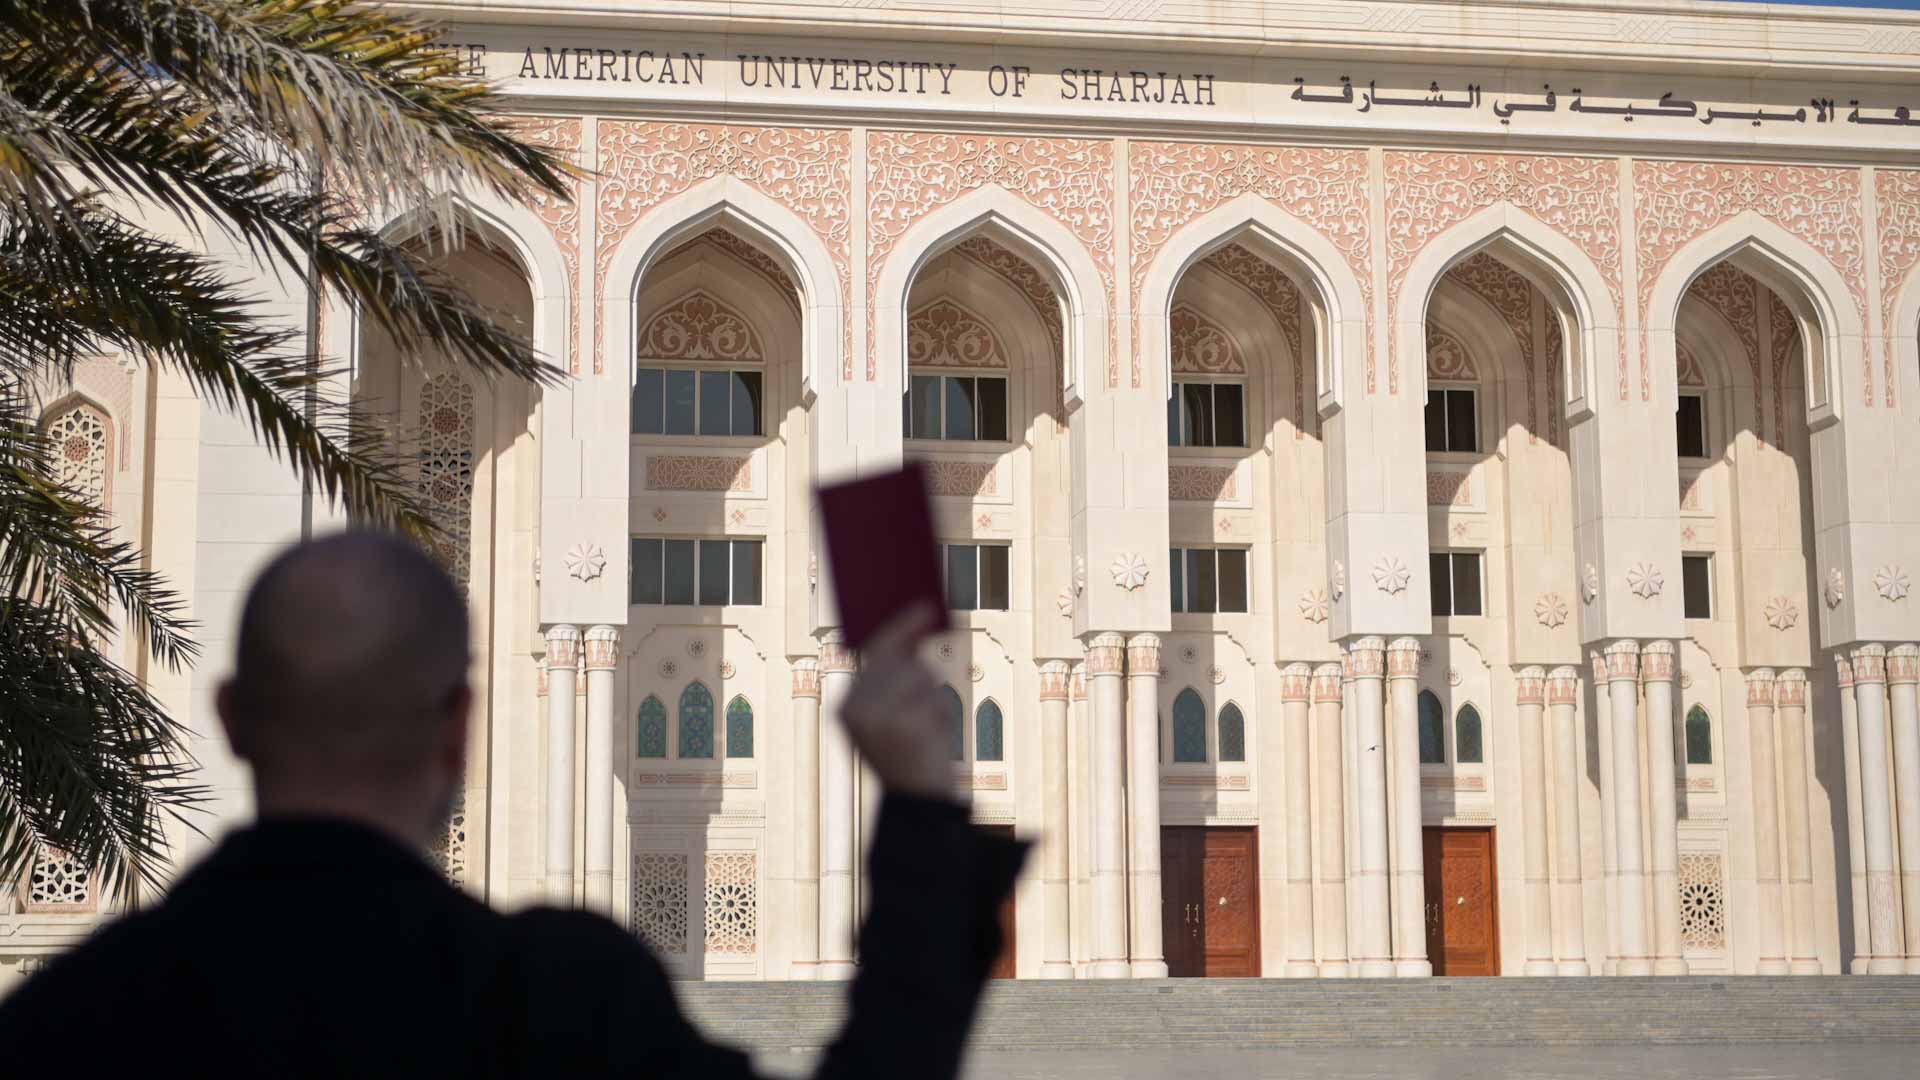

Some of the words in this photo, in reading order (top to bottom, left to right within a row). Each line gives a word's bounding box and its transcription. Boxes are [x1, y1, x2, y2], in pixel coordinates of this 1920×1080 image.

[518, 45, 705, 84] AMERICAN
[737, 54, 957, 95] UNIVERSITY
[988, 65, 1030, 97] OF
[1060, 68, 1216, 106] SHARJAH
[1290, 76, 1481, 113] الشارقة
[1493, 83, 1557, 125] في
